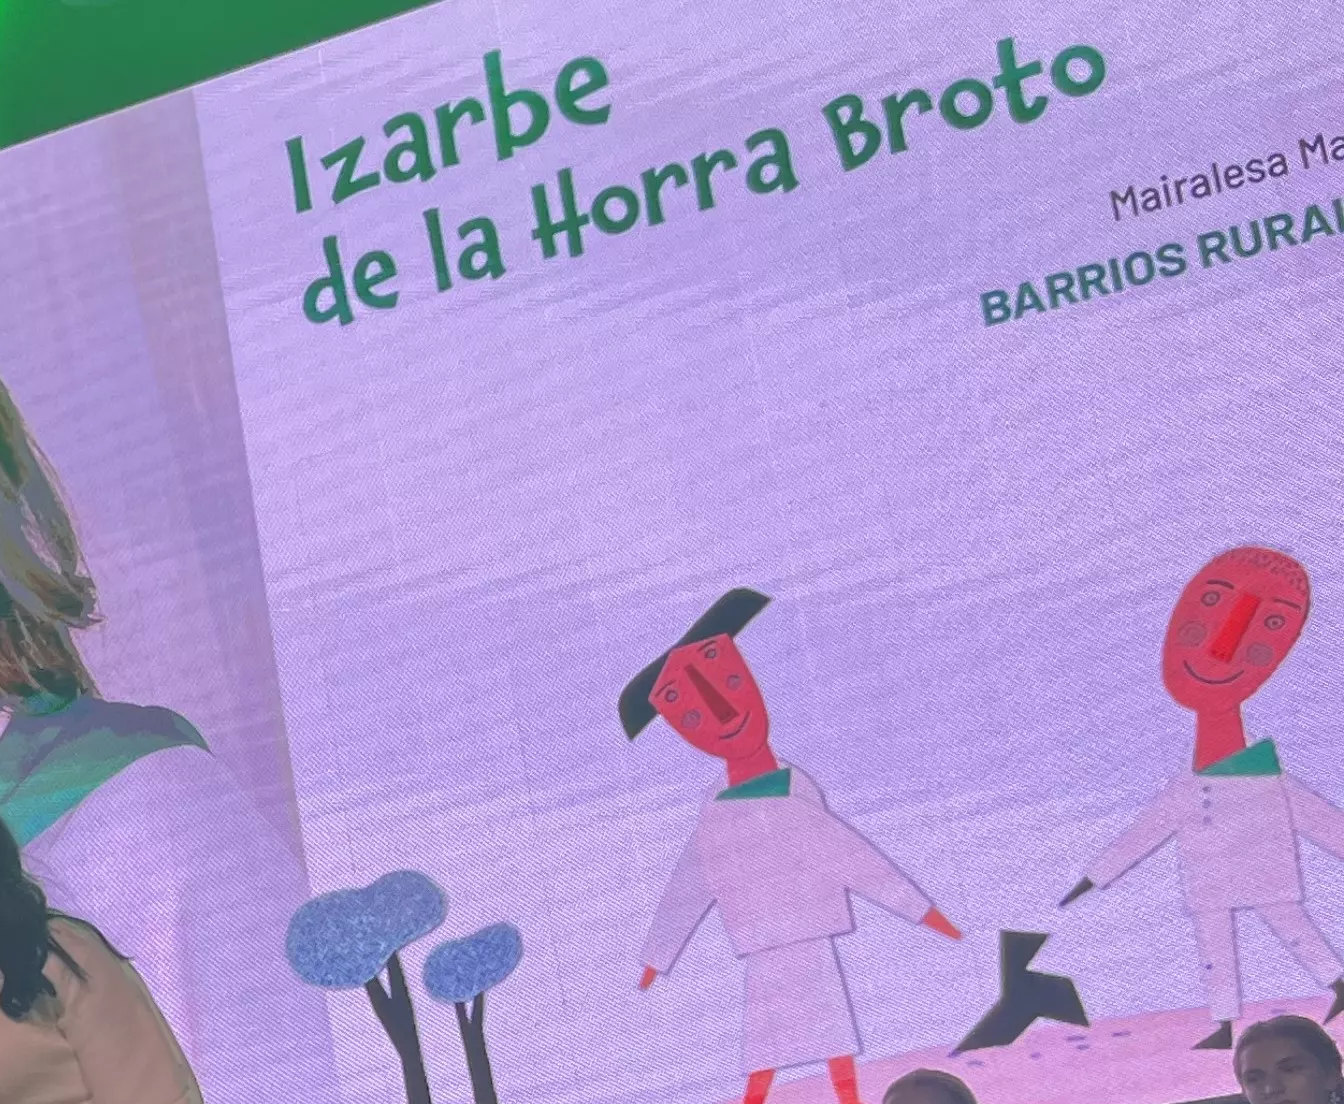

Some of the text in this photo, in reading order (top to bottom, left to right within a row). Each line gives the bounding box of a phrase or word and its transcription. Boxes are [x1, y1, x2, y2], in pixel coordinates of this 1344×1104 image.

[284, 48, 612, 214] Izarbe
[302, 36, 1107, 326] de la Horra Broto
[1108, 151, 1290, 222] Mairalesa
[979, 241, 1188, 327] BARRIOS
